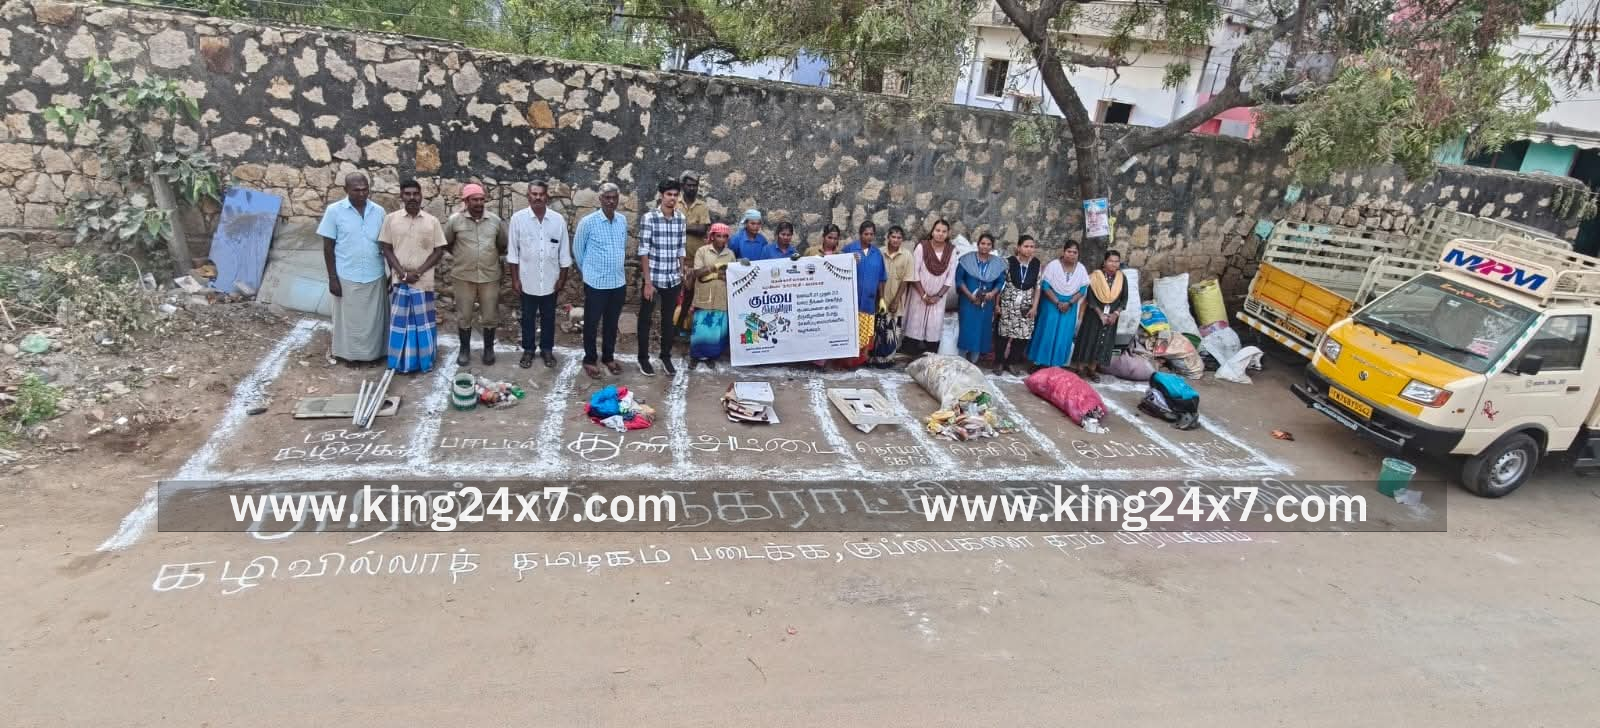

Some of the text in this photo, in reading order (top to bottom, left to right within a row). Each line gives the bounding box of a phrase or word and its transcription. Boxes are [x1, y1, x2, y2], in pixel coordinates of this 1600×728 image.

[1443, 248, 1547, 291] MPM
[749, 291, 793, 309] குப்பை
[689, 435, 837, 454] அட்டை
